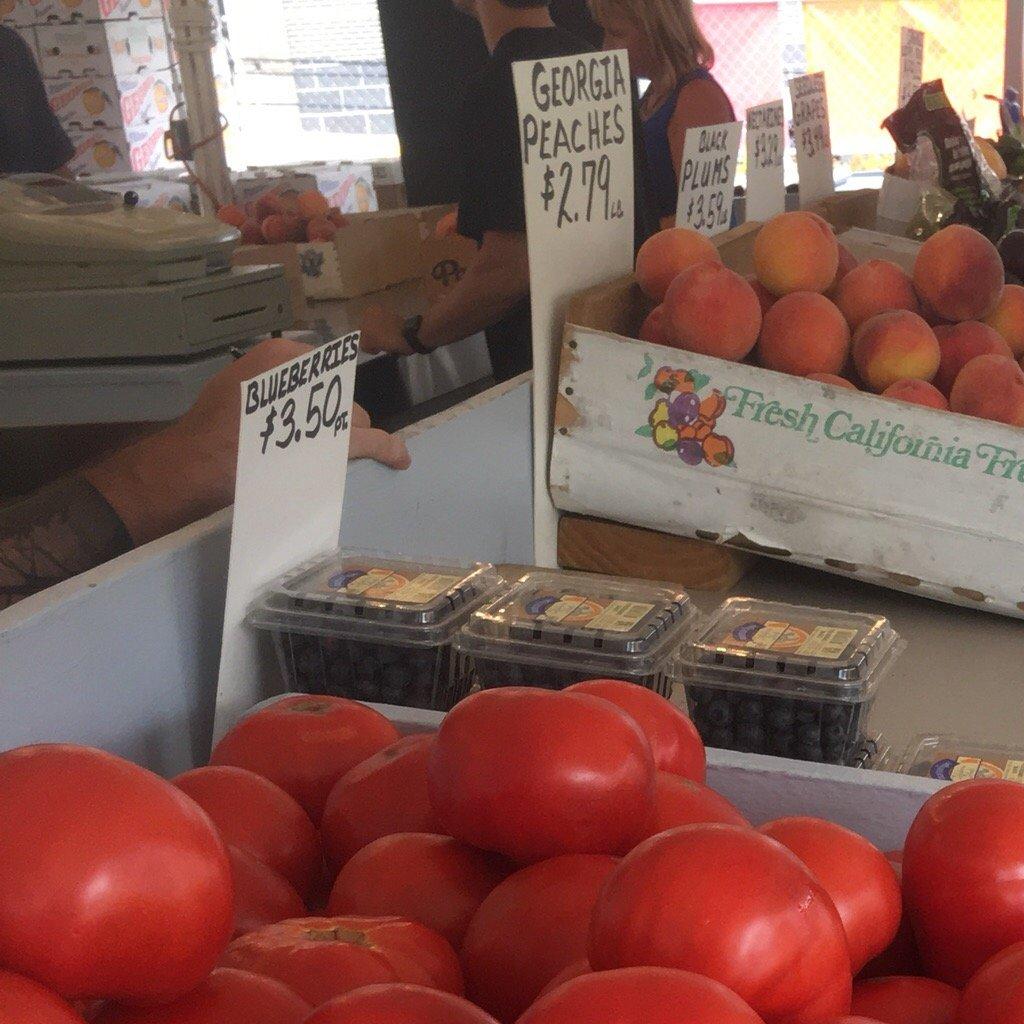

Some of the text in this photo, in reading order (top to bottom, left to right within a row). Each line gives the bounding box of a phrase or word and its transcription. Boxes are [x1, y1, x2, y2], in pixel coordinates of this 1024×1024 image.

[532, 54, 626, 112] GEORGIA
[523, 104, 625, 164] PEACHES
[699, 129, 729, 152] BLACK
[541, 154, 610, 228] $2.79
[681, 155, 731, 191] PLUMS
[246, 334, 360, 414] BLUEBERRIES
[260, 375, 342, 453] $3.50
[724, 386, 818, 443] Fresh
[822, 410, 972, 472] California
